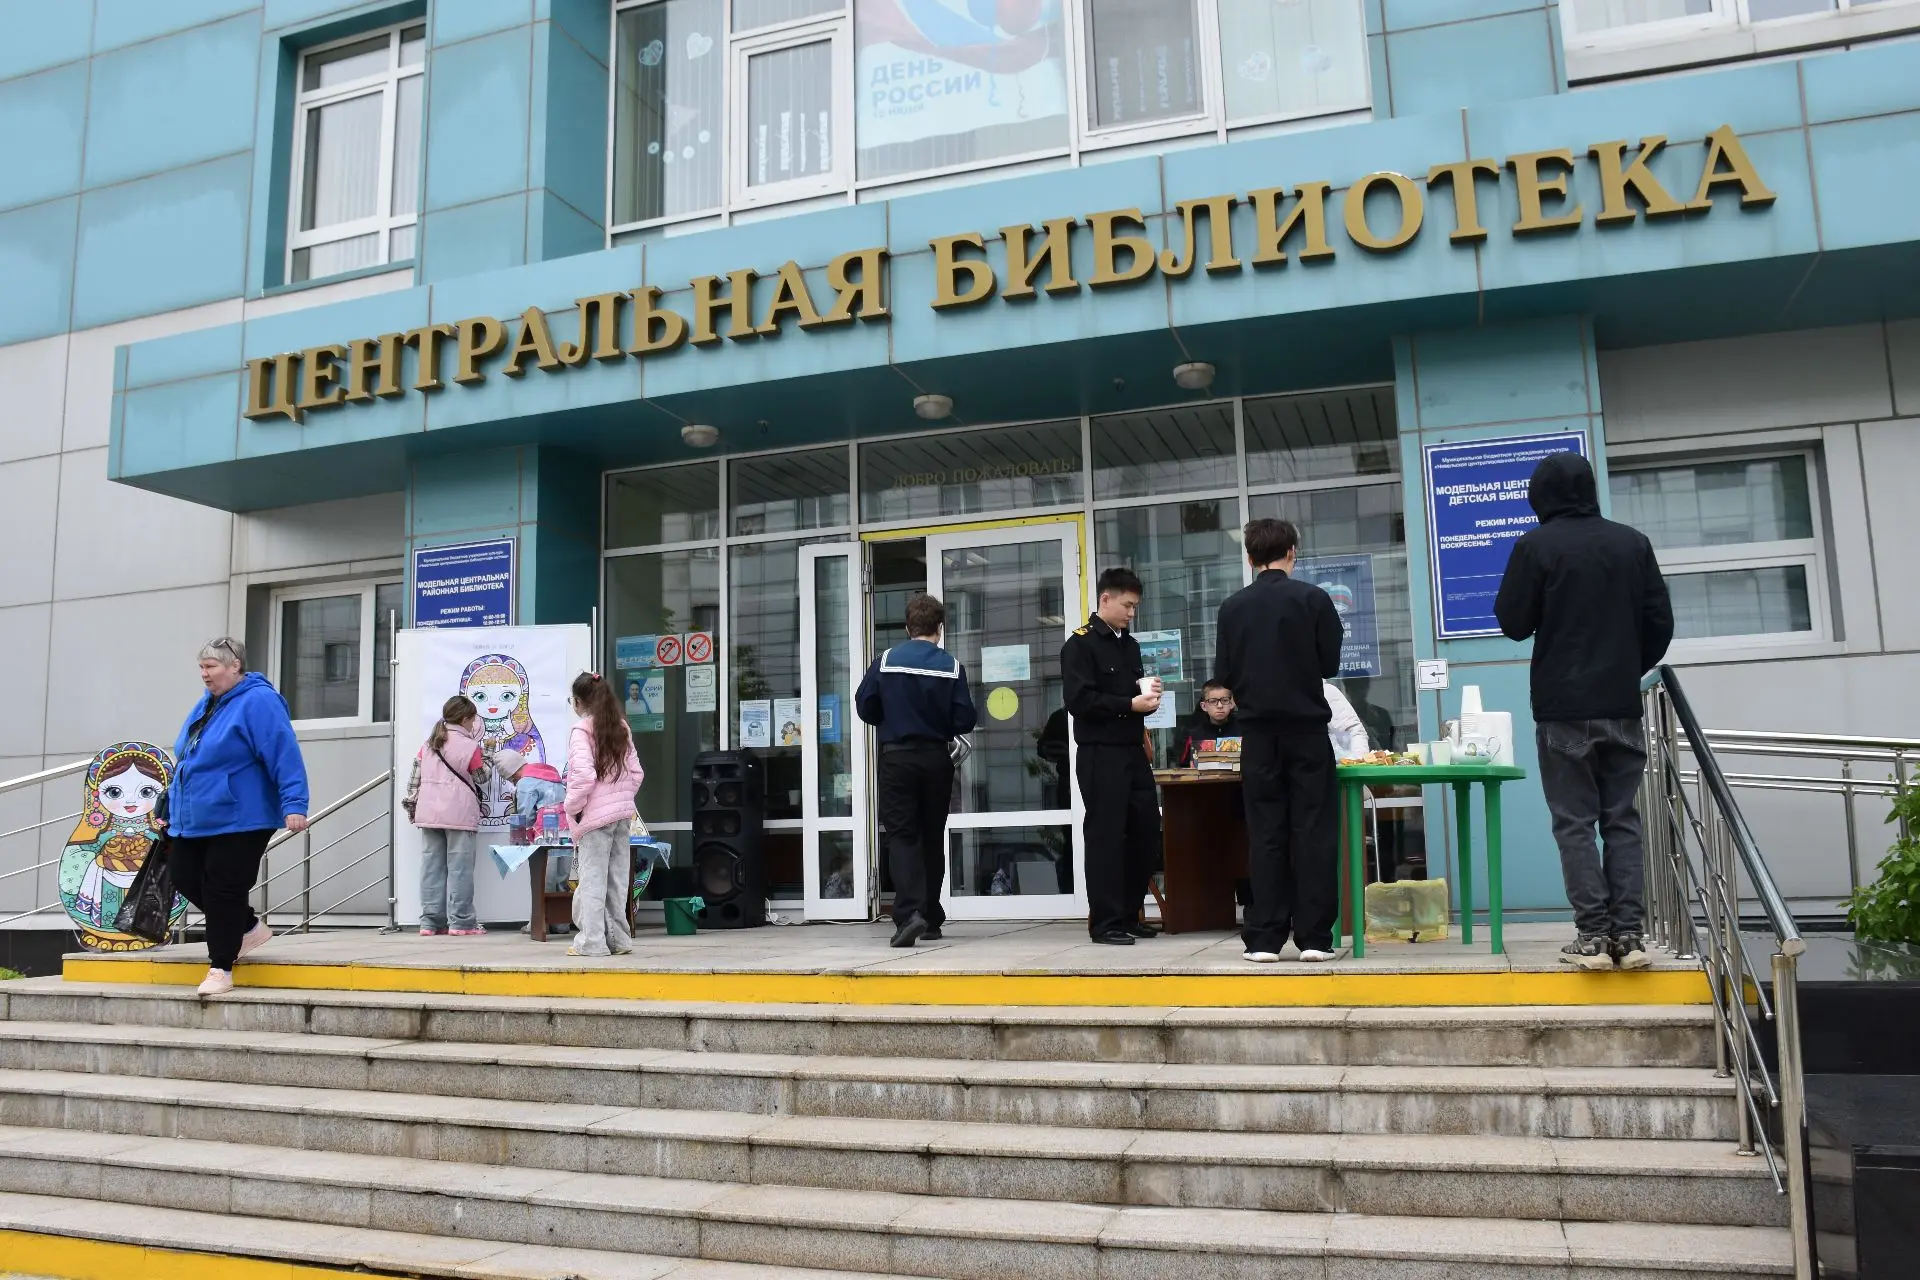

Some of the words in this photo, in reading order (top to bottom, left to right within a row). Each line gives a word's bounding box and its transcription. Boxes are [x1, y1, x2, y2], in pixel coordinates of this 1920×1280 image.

[870, 57, 944, 88] ДЕНЬ
[872, 71, 982, 108] РОССИИ
[243, 246, 892, 424] ЦЕНТРАЛЬНАЯ
[929, 123, 1778, 312] БИБЛИОТЕКА
[893, 472, 946, 488] ДОБРО
[1436, 483, 1501, 496] МОДЕЛЬНАЯ
[1449, 494, 1497, 506] ДЕТСКАЯ
[1475, 519, 1506, 528] РЕЖИМ
[1440, 540, 1493, 550] ВОСКРЕСЕНЬЕ:
[417, 579, 459, 589] МОДЕЛЬНАЯ
[460, 573, 509, 585] ЦЕНТРАЛЬНАЯ
[422, 587, 459, 597] РАЙОННАЯ
[460, 581, 504, 593] БИБЛИОТЕКА
[440, 607, 460, 615] РЕЖИМ
[1339, 660, 1372, 671] ВЕДЕВА
